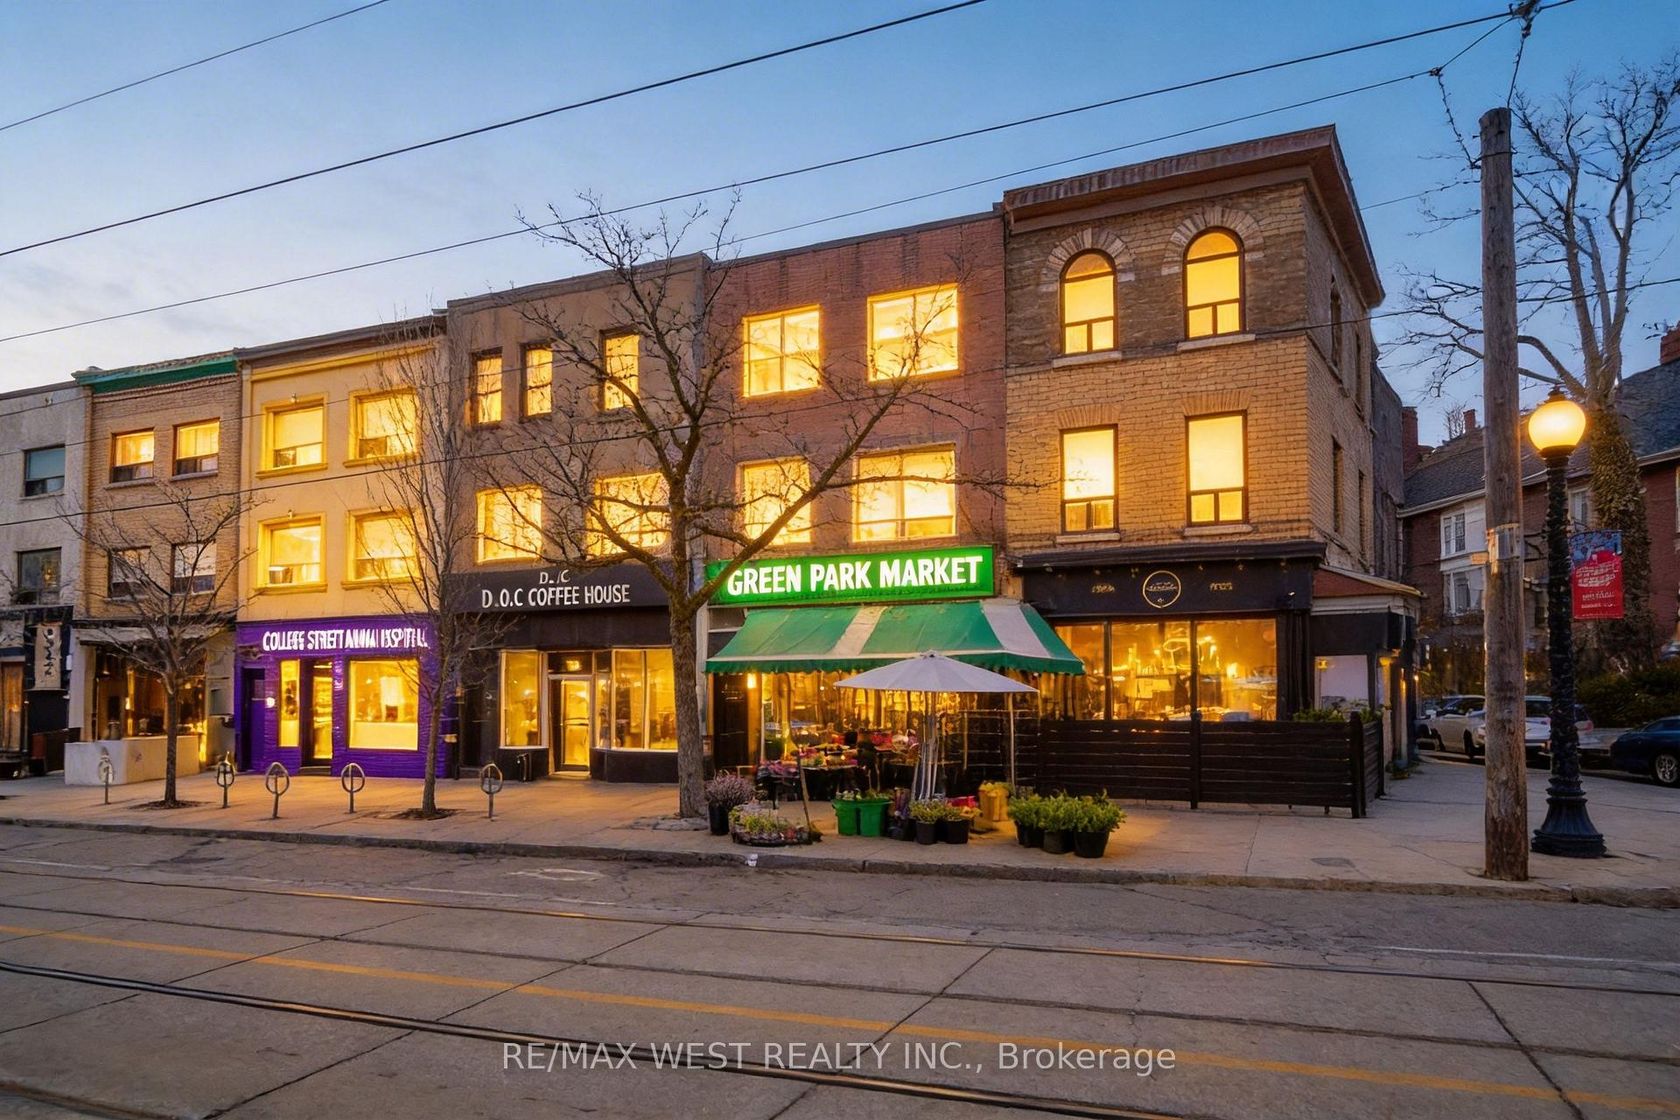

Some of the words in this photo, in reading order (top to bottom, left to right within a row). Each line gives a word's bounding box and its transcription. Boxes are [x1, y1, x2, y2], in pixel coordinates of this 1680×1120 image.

[727, 564, 801, 596] GREEN
[810, 561, 872, 592] PARK
[879, 556, 983, 588] MARKET
[528, 586, 579, 606] COFFEE
[584, 584, 630, 603] HOUSE
